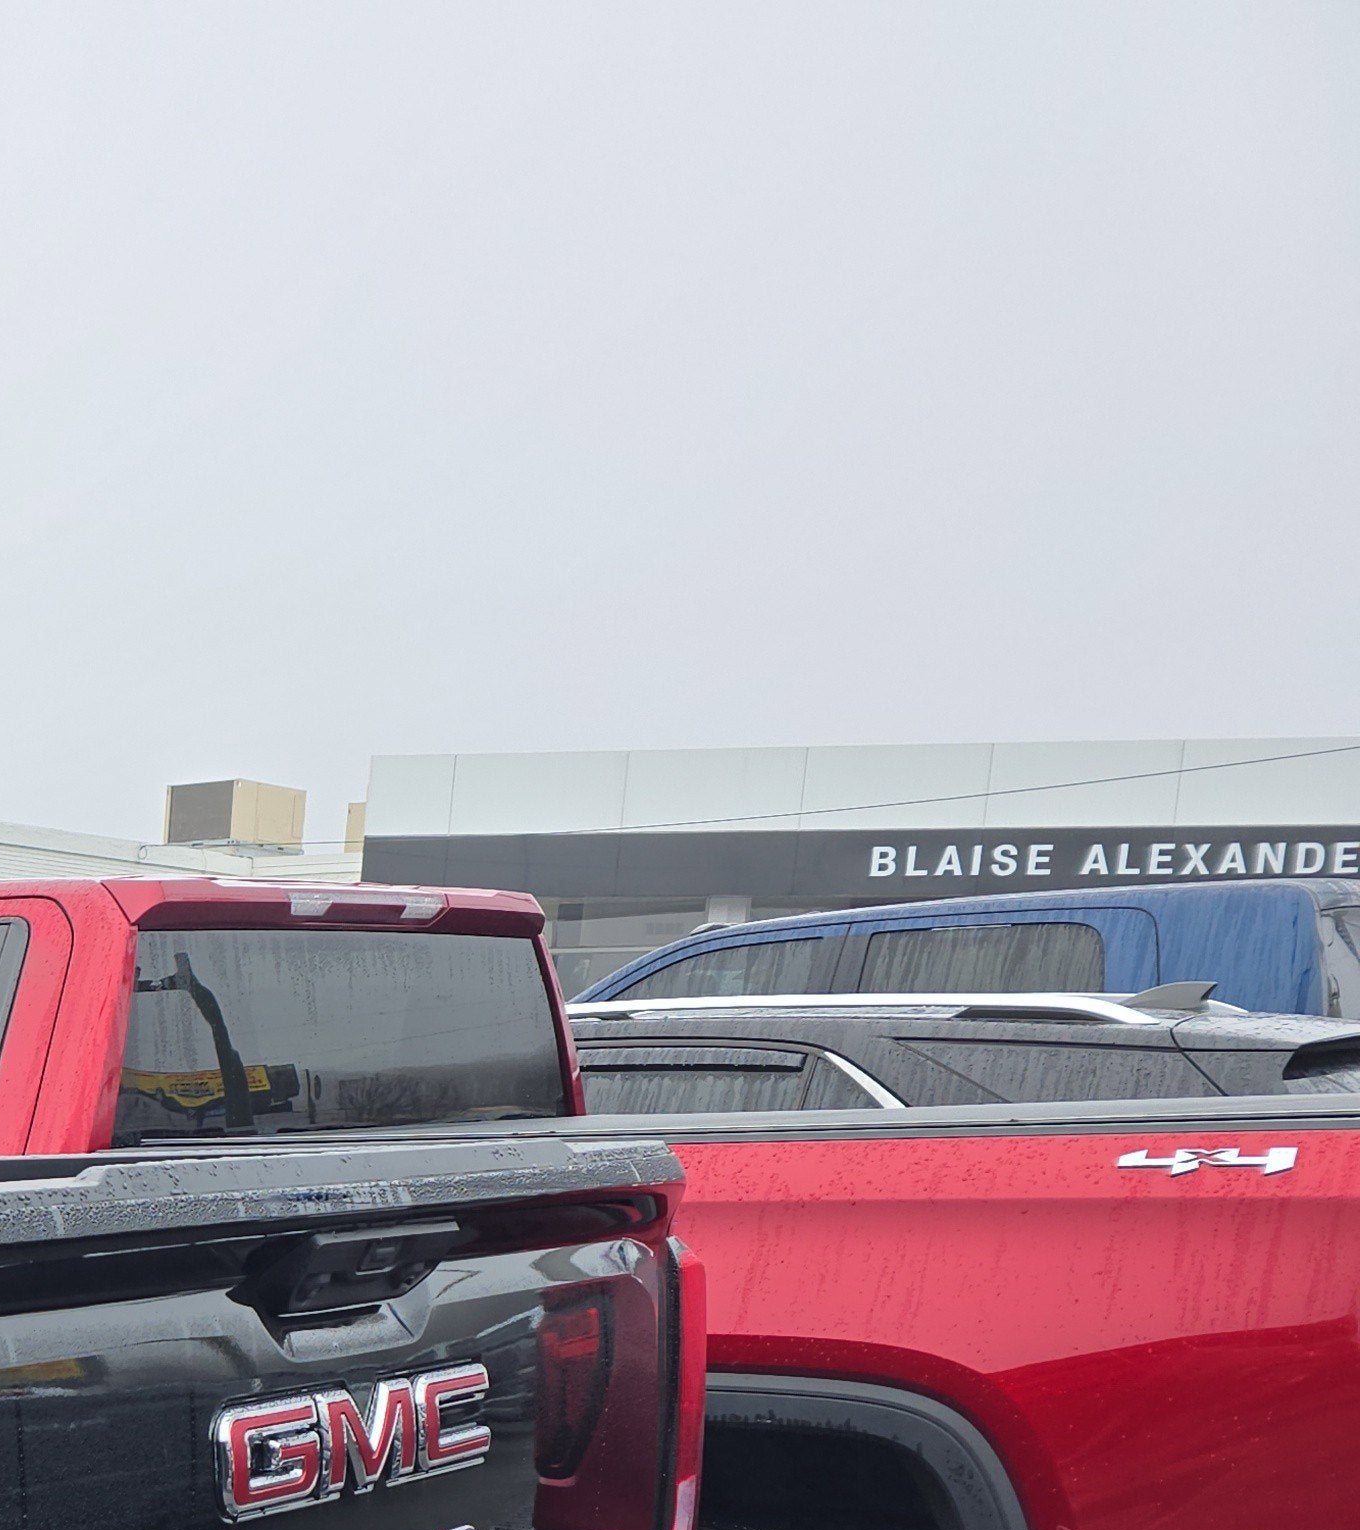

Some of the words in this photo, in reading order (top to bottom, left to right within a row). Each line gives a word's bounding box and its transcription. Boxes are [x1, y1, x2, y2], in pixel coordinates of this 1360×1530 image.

[868, 844, 1053, 877] BLAISE
[1079, 842, 1360, 875] ALEXANDE
[210, 1362, 492, 1523] GMC
